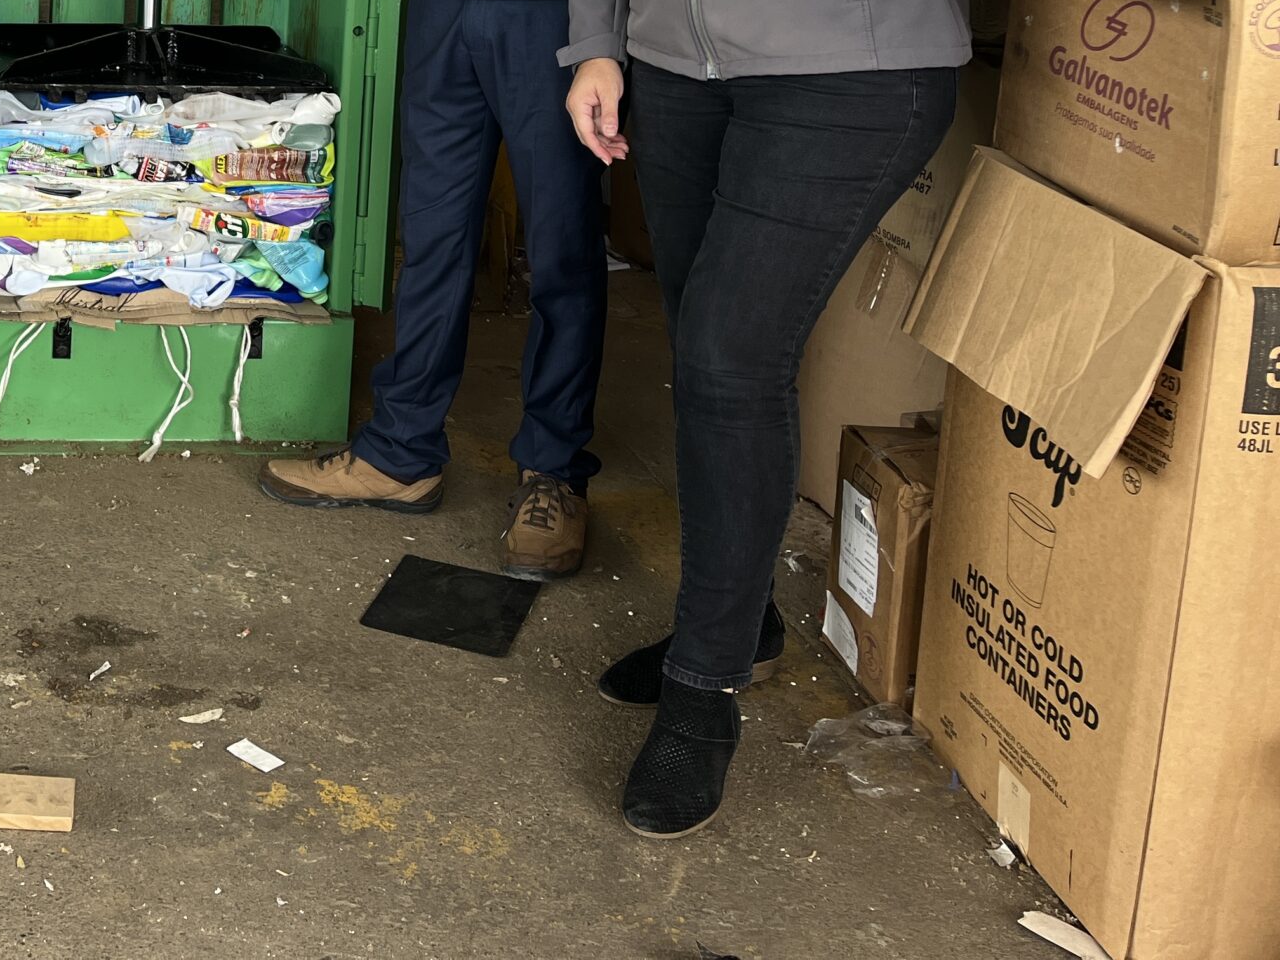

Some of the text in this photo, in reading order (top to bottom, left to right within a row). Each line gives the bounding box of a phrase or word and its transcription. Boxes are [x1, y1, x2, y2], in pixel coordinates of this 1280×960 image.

[1048, 45, 1174, 130] Galvanotek
[1054, 102, 1098, 133] Protegemos
[1098, 126, 1113, 141] sua
[1076, 92, 1139, 130] EMBALAGENS
[217, 154, 227, 174] ALEX
[220, 211, 243, 239] Cif
[882, 229, 911, 251] SOMBRA
[54, 286, 139, 313] Mistral
[1237, 438, 1274, 454] 48JL
[1238, 420, 1271, 436] USE
[967, 563, 1083, 683] HOT OR COLD
[951, 578, 1099, 730] INSULATED FOOD
[966, 625, 1071, 741] CONTAINERS
[984, 709, 1016, 742] CONTAINER
[1016, 741, 1058, 788] CORPORATION
